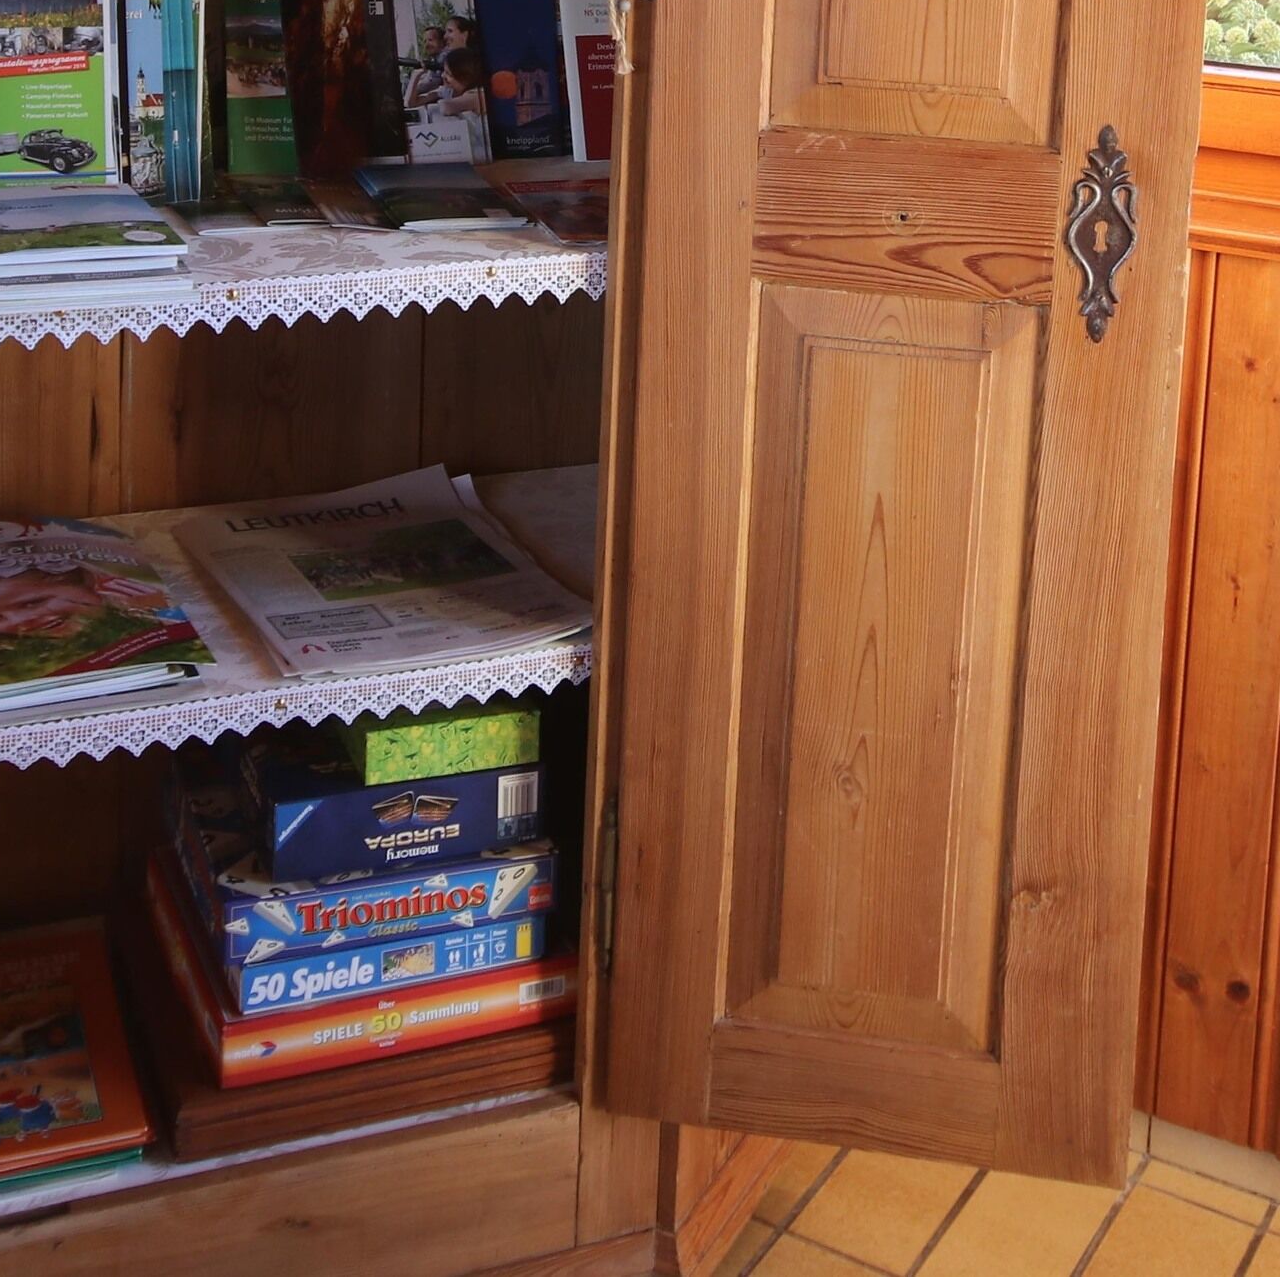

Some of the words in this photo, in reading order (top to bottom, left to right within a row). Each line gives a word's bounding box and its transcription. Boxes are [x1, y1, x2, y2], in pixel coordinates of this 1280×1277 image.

[225, 497, 405, 533] LEUTKIRCH
[364, 823, 461, 850] EUROPA
[386, 844, 439, 863] memory
[296, 882, 488, 936] Triominos
[368, 921, 418, 938] Classic
[247, 972, 286, 1006] 50
[289, 955, 375, 1002] Spiele
[378, 1000, 396, 1010] Über
[312, 1022, 365, 1045] SPIELE
[371, 1011, 403, 1035] 50
[409, 1000, 480, 1024] Sammlung
